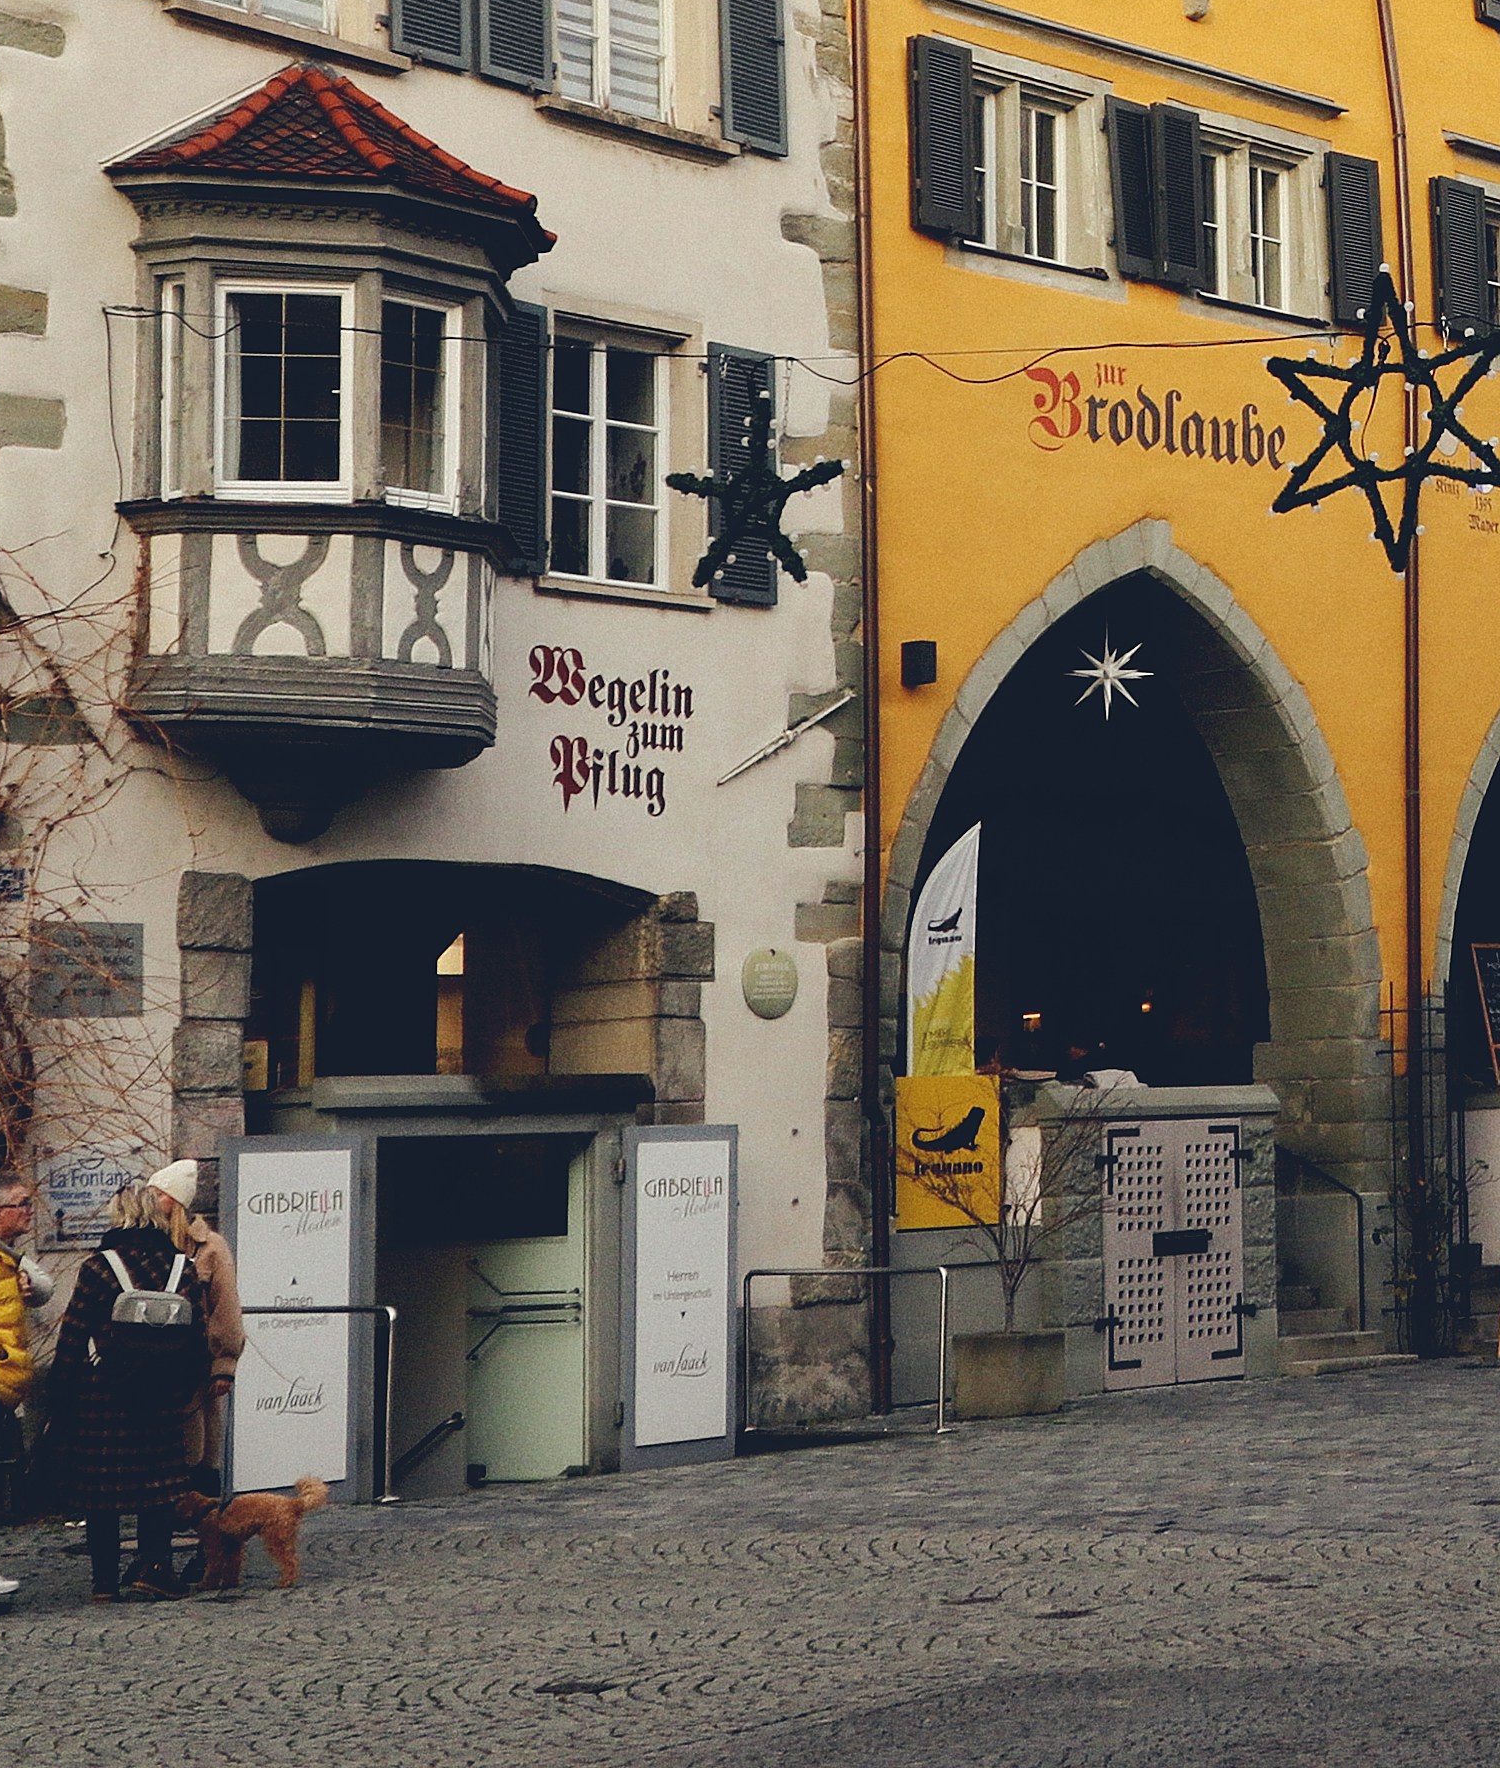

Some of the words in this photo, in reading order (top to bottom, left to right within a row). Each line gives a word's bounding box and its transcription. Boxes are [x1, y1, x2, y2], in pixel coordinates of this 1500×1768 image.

[1096, 362, 1127, 387] zur
[1023, 367, 1286, 470] Brodlaube
[528, 645, 694, 727] Wegelin
[626, 720, 684, 759] zum
[550, 735, 666, 817] Pflug
[49, 1170, 66, 1188] La
[71, 1170, 132, 1187] Fontana
[645, 1176, 723, 1198] GABRIELLA
[248, 1189, 343, 1214] GABRIELLA
[667, 1271, 699, 1281] Herren
[274, 1295, 313, 1308] Damen
